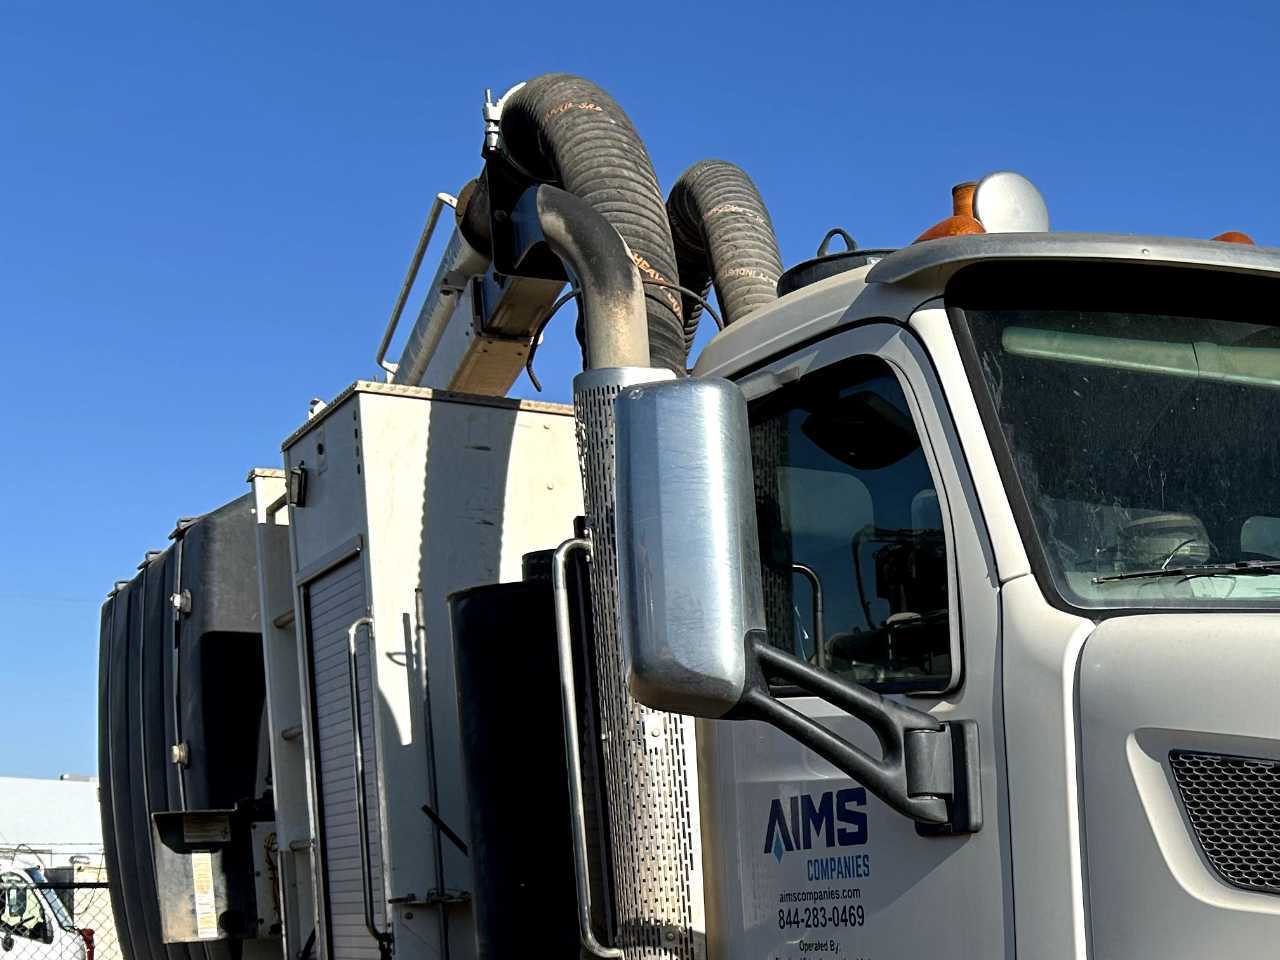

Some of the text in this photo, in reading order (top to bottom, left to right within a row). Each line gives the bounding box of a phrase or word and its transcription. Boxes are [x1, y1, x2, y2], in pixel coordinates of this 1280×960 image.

[764, 787, 868, 854] AIMS
[807, 854, 870, 881] COMPANIES
[779, 888, 861, 904] aimscompanies.com
[778, 905, 865, 929] 844-283-0469
